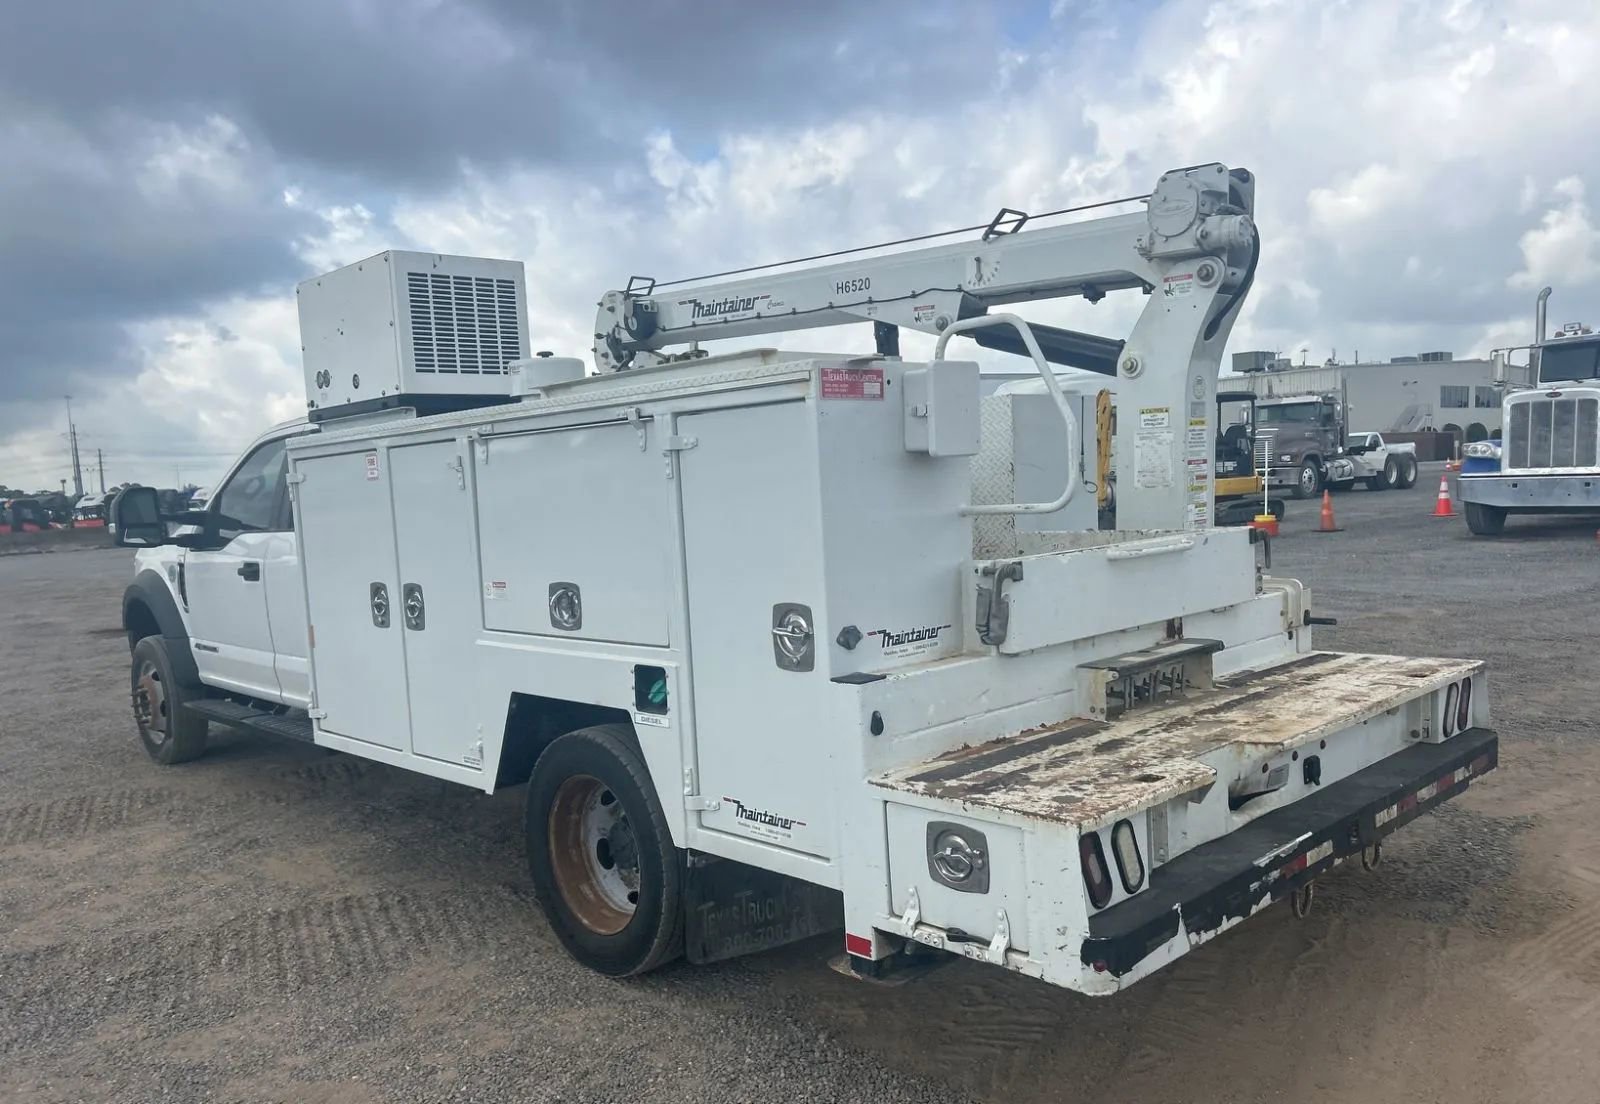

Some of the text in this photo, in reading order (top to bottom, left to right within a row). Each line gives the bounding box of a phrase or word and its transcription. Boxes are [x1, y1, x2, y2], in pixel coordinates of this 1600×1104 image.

[835, 276, 871, 295] H6520
[688, 295, 760, 319] Maintainer
[877, 625, 941, 649] Maintainer
[640, 716, 663, 725] DIESEL
[732, 799, 797, 830] Maintainer
